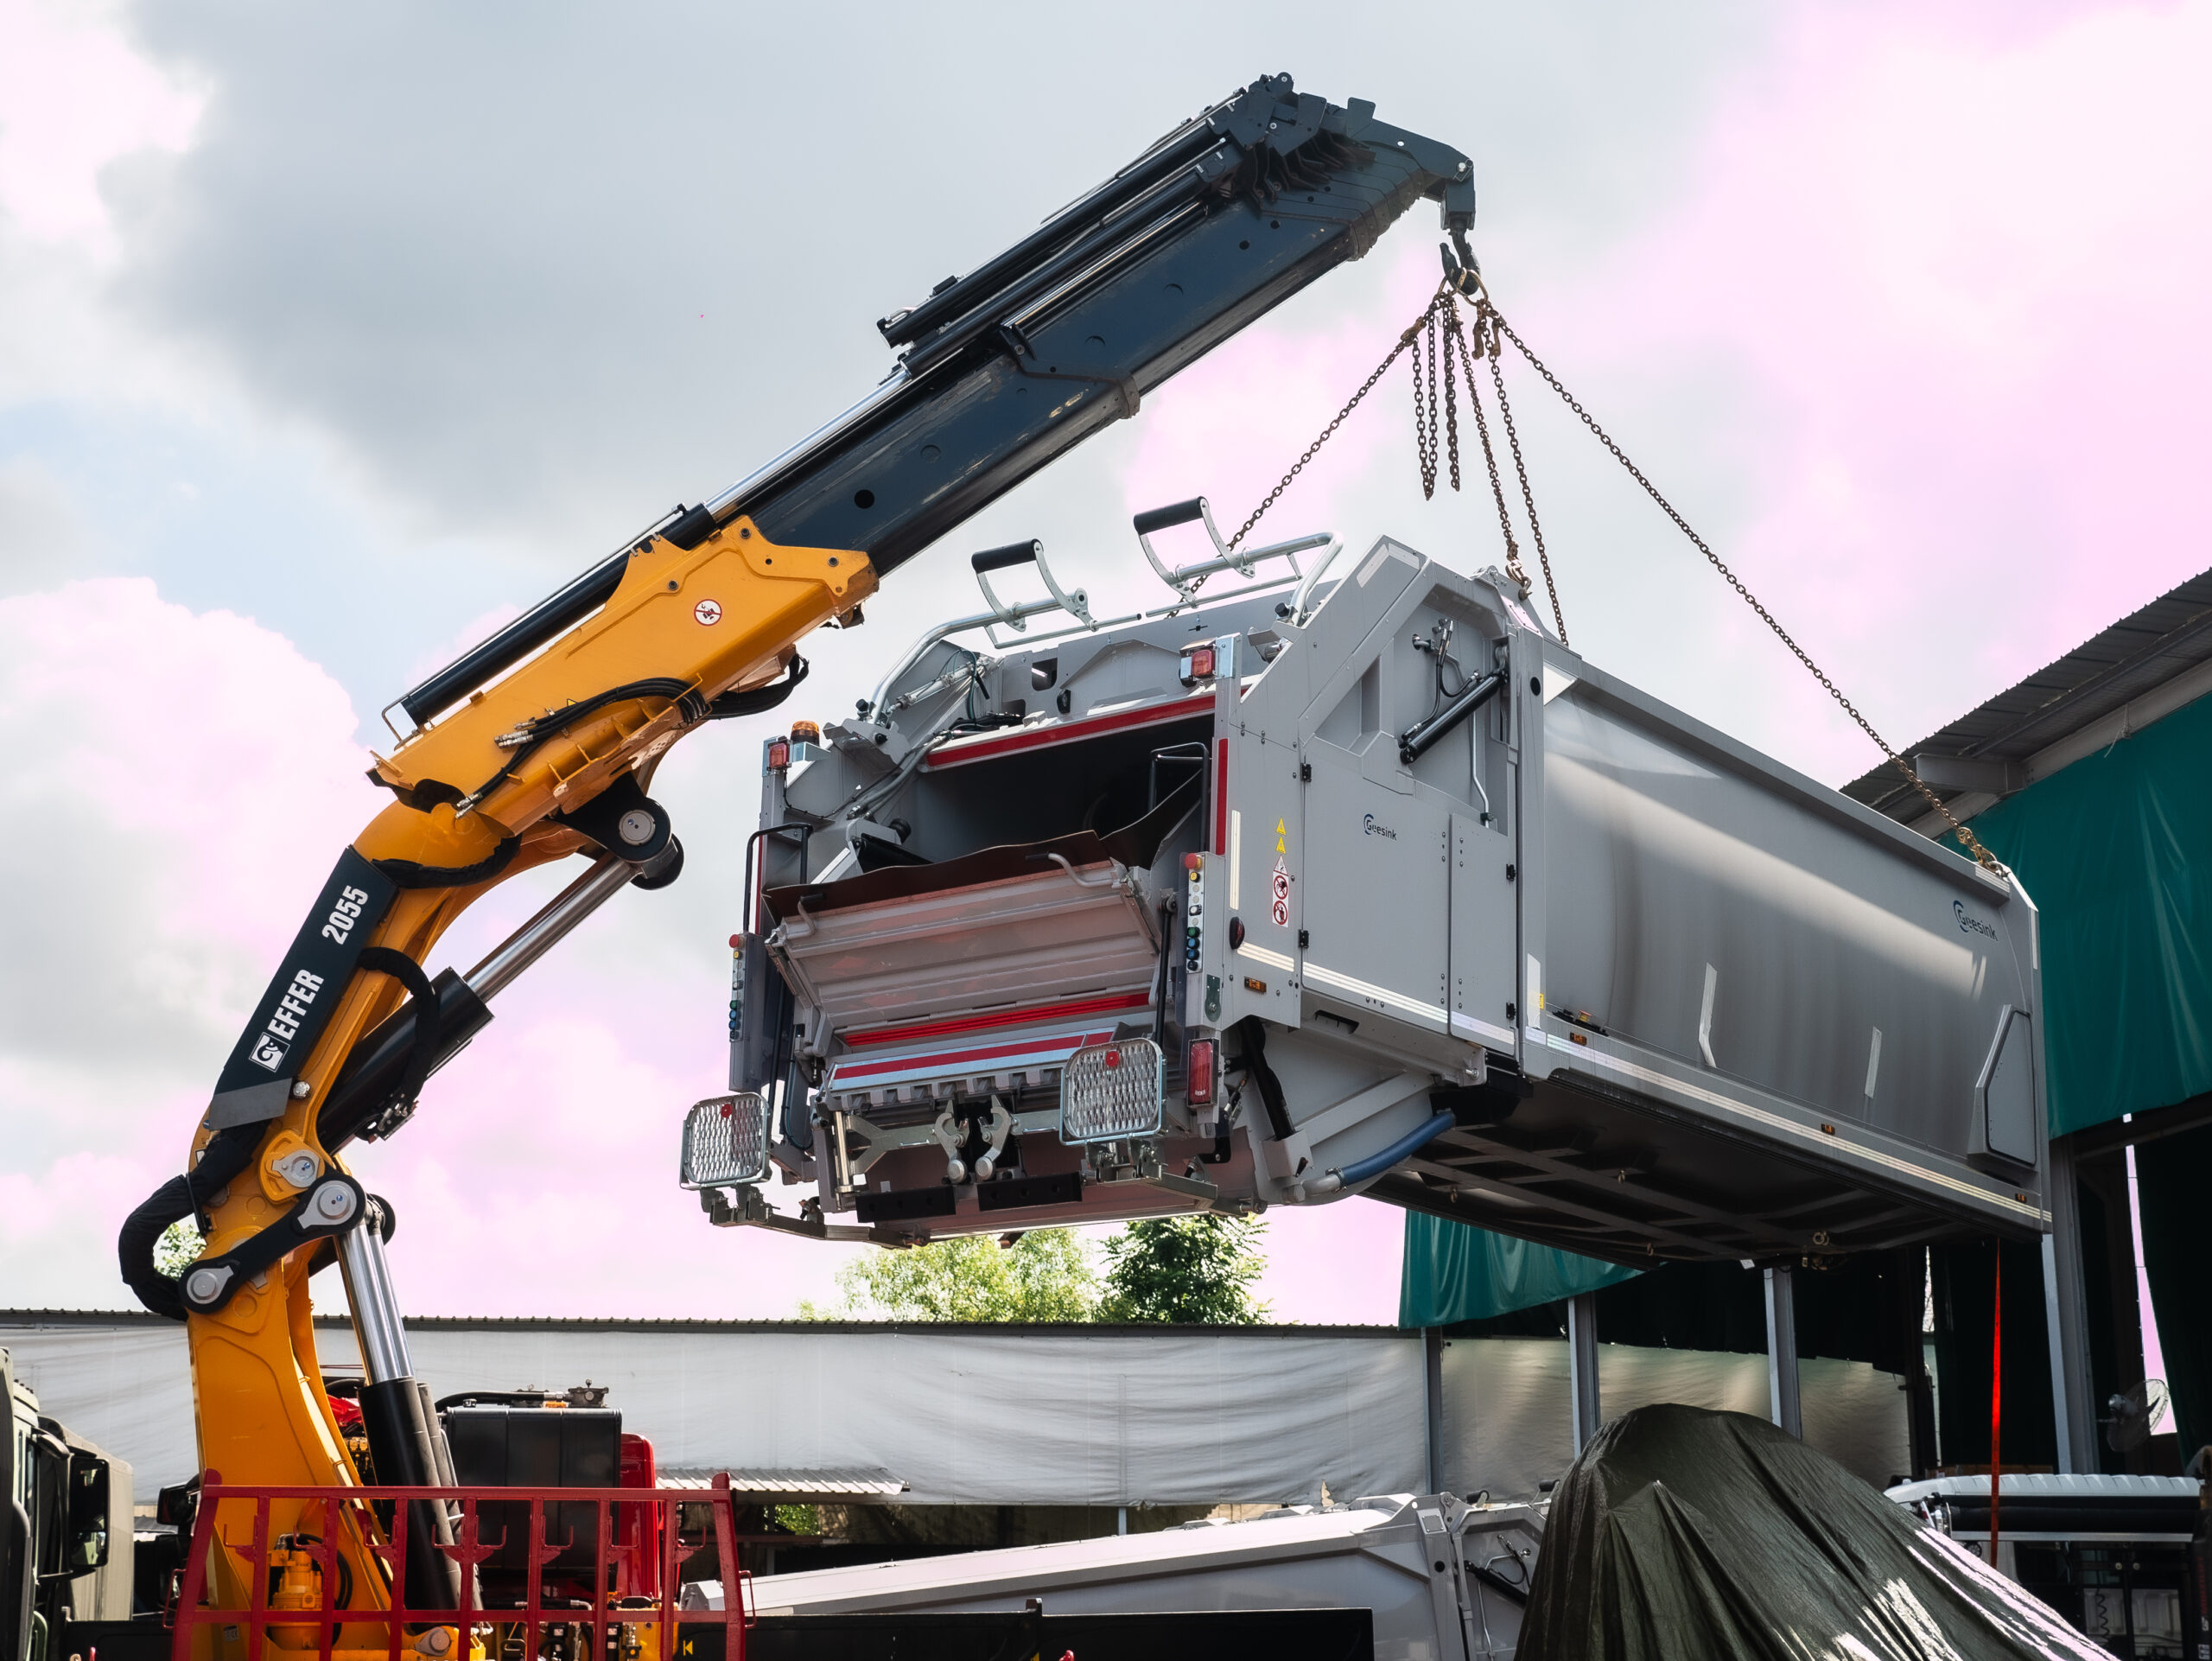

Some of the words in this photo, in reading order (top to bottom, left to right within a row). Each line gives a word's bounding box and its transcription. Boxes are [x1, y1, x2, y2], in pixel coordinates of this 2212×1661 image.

[1364, 816, 1397, 841] Geesink
[1955, 904, 1999, 942] Geesink
[267, 969, 325, 1041] EFFER
[321, 885, 369, 945] 2055
